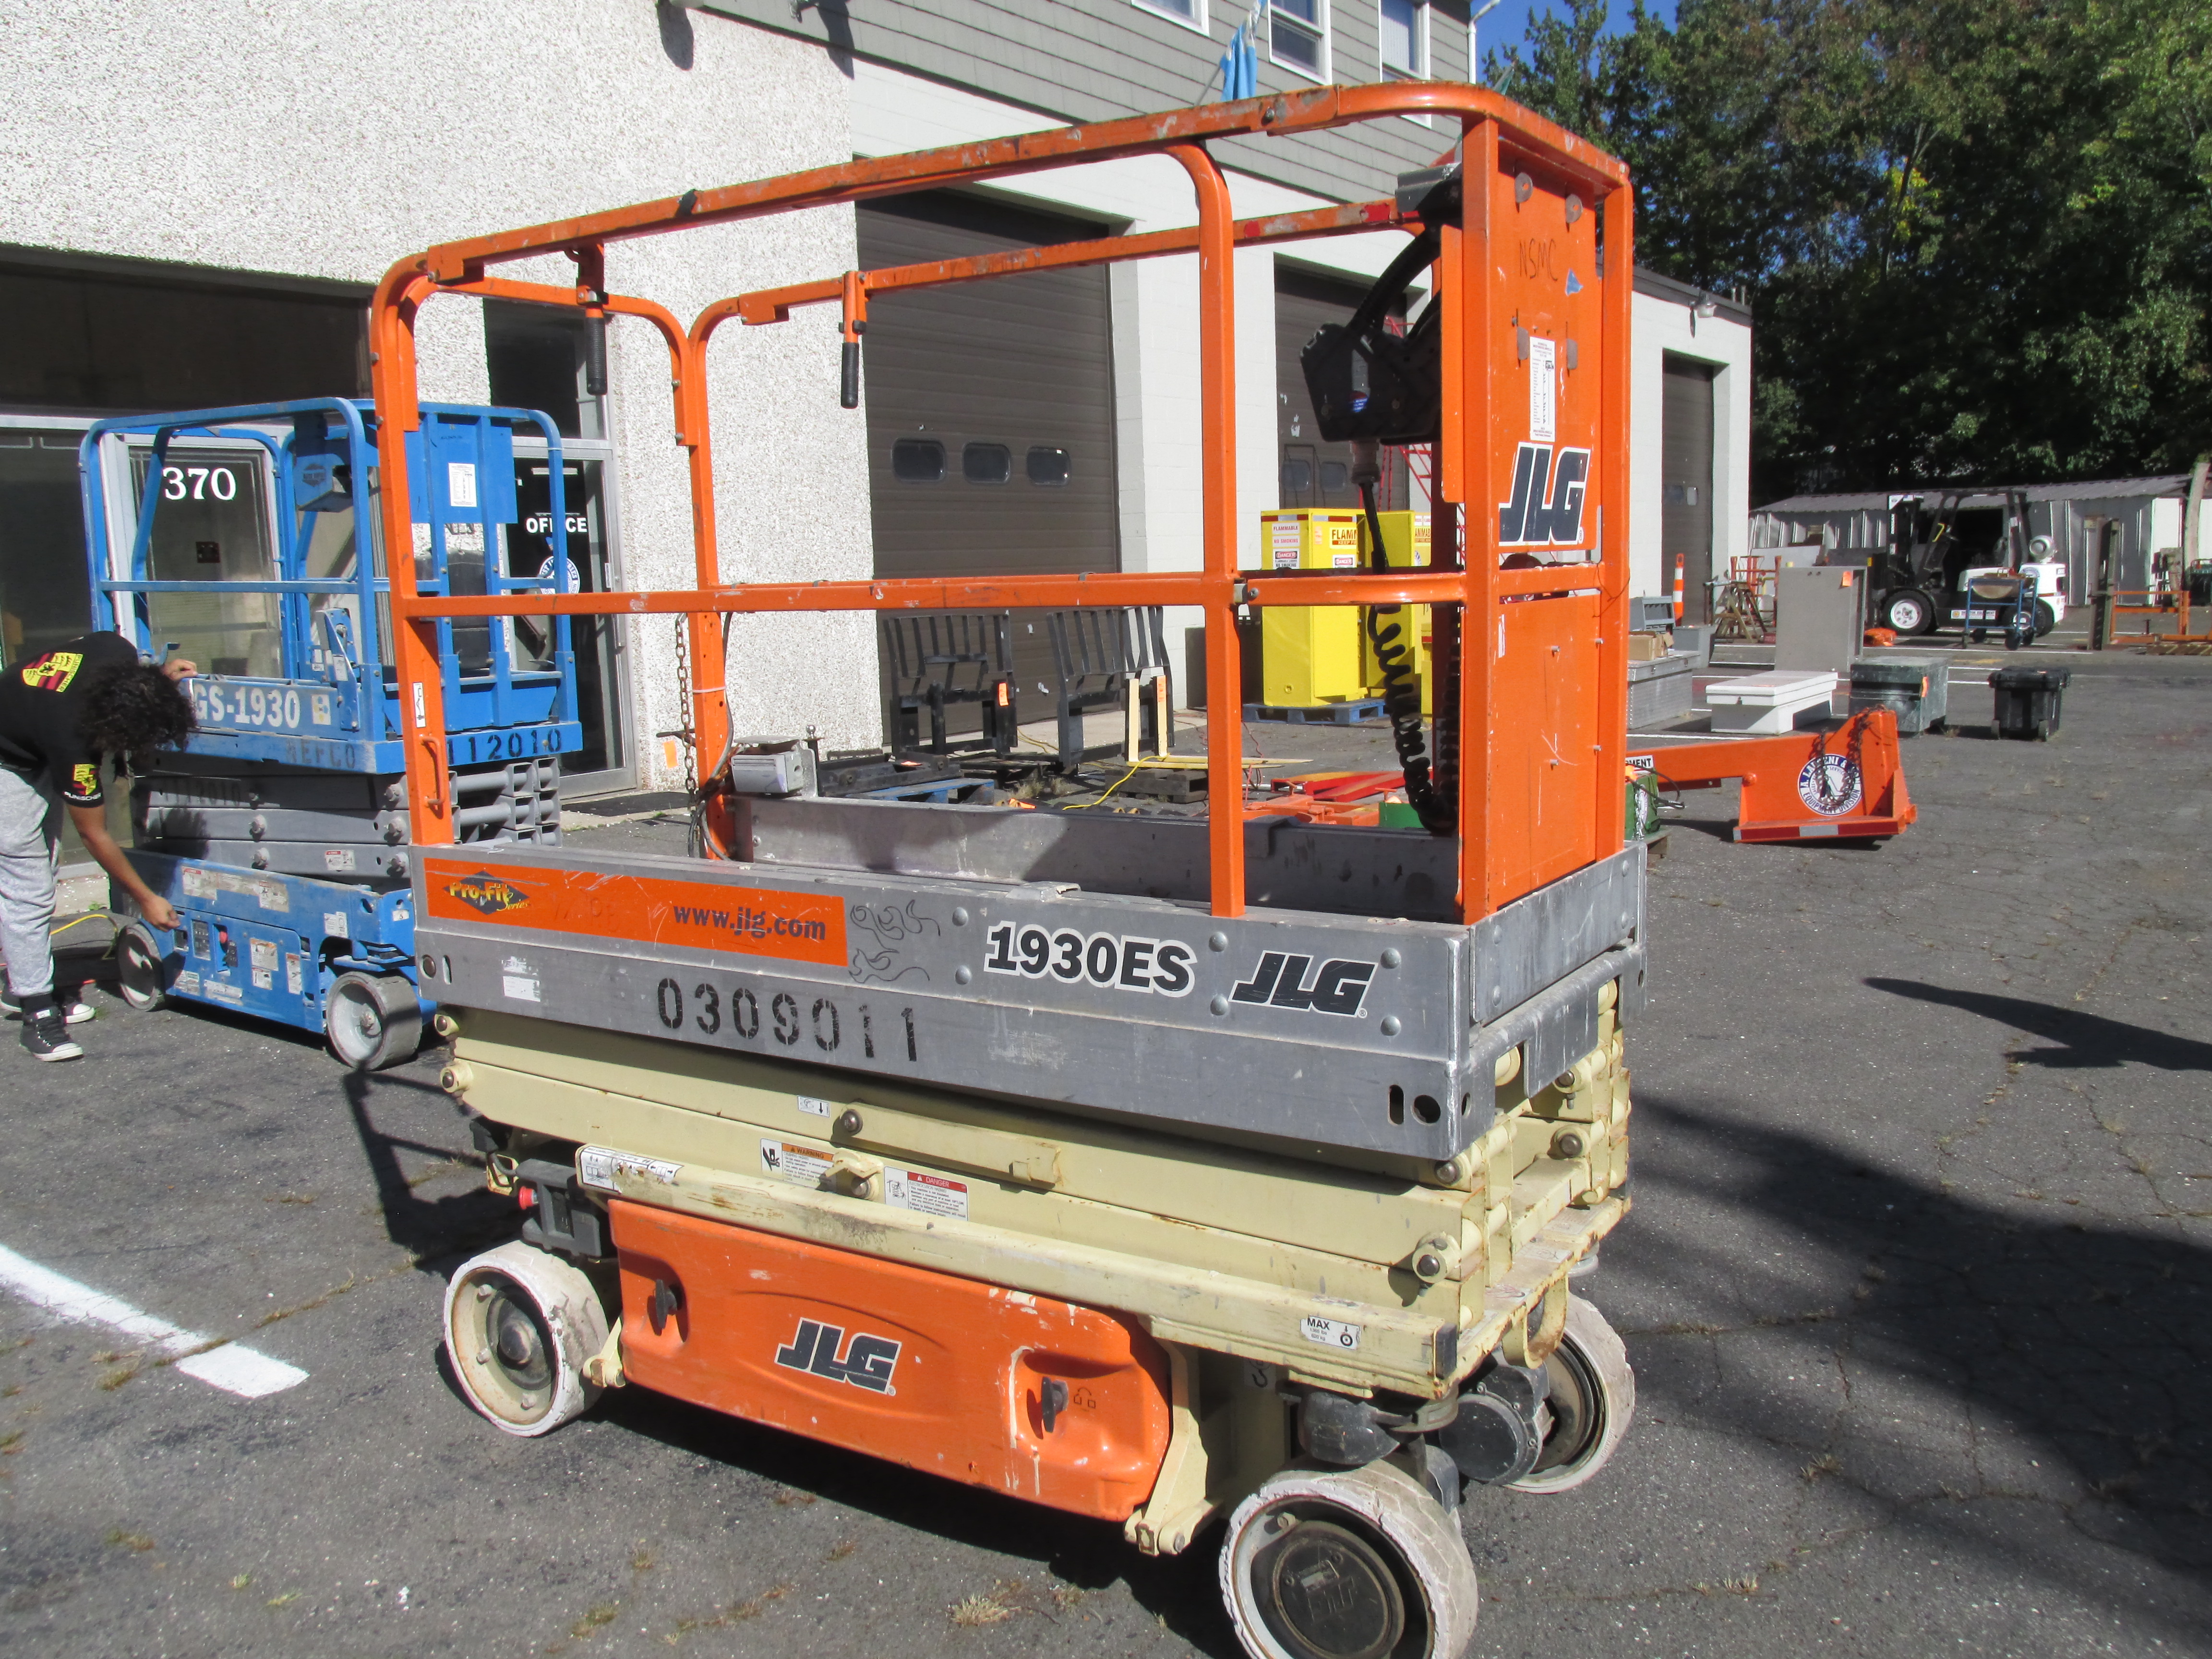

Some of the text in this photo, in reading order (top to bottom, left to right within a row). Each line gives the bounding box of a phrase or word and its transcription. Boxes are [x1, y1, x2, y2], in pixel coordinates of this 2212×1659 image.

[162, 467, 237, 501] 370
[1498, 442, 1591, 546] JLG
[526, 517, 588, 533] OFCE
[193, 684, 301, 729] GS-1930
[1839, 789, 1861, 812] DIVISION
[449, 880, 511, 902] Pro-Fit
[496, 894, 531, 912] Series
[673, 905, 826, 941] www.jlg.com
[984, 920, 1197, 998] 1930ES
[1228, 950, 1378, 1018] JLG
[796, 1147, 824, 1159] WARNING
[926, 1177, 950, 1188] DANGER
[1307, 1317, 1330, 1331] MAX
[774, 1317, 902, 1395] JLG
